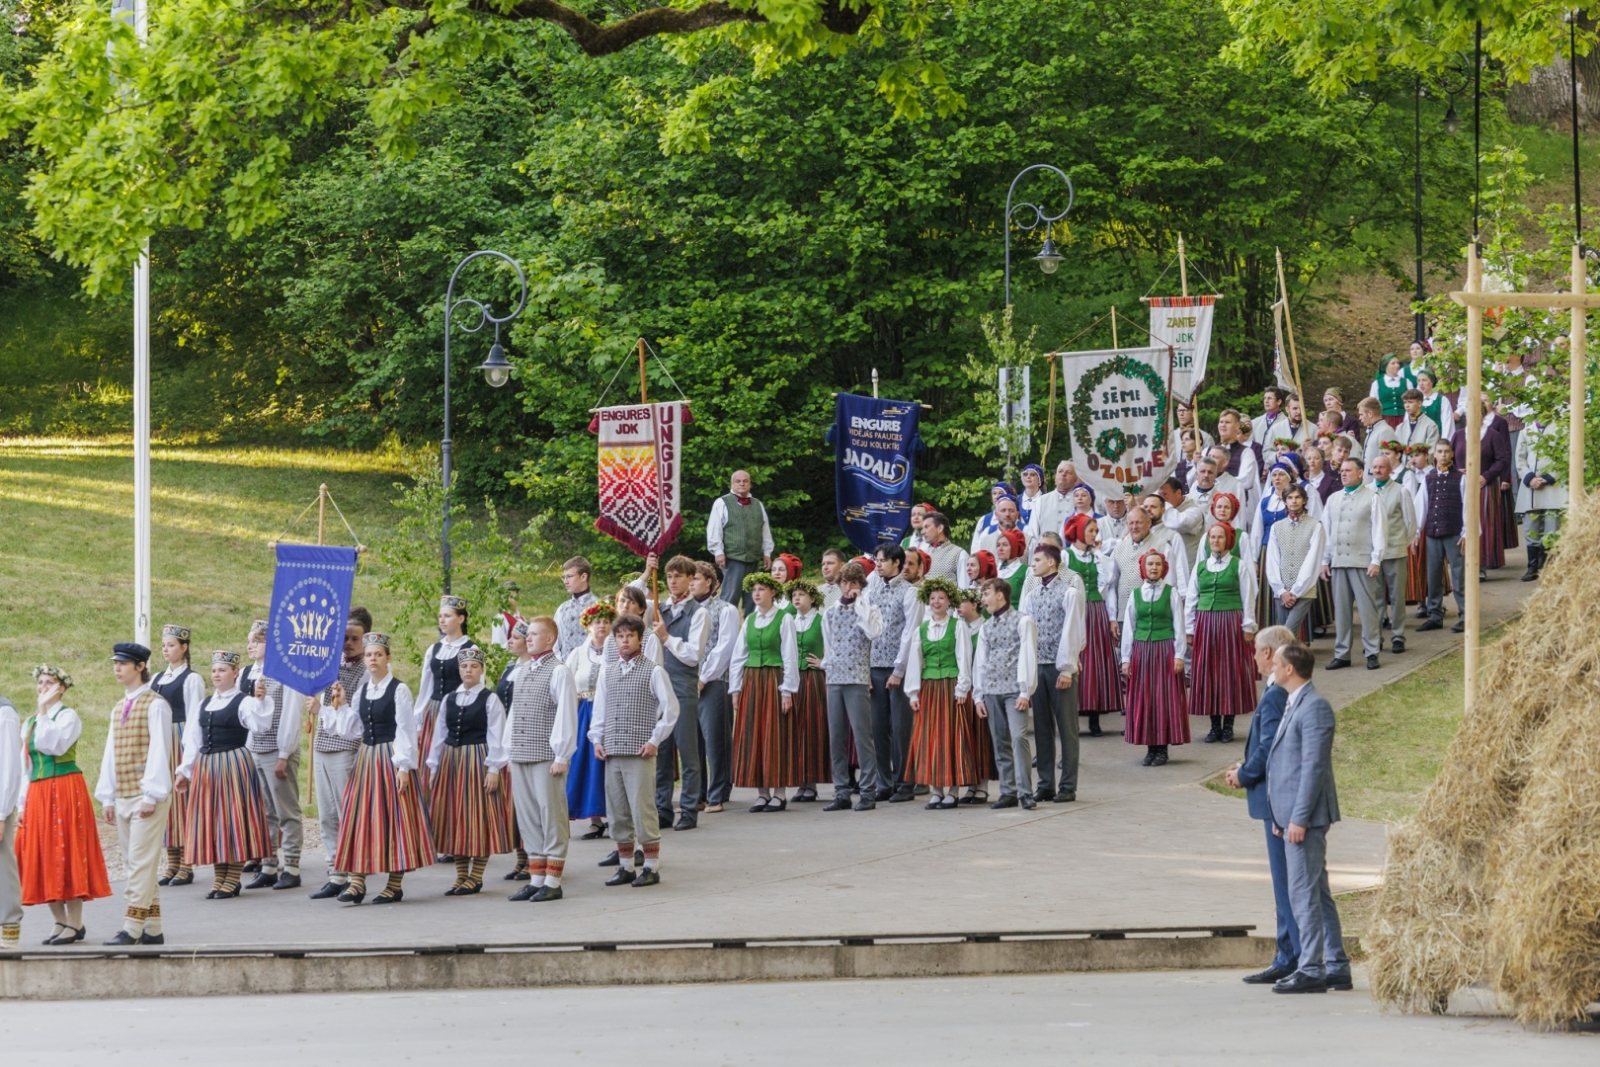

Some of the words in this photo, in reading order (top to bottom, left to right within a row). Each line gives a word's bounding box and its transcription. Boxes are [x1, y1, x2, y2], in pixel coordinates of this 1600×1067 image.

[1176, 333, 1194, 343] JDK
[601, 408, 651, 421] ENGURES
[615, 424, 639, 434] JDK
[660, 405, 674, 519] UNGURS
[288, 641, 329, 660] ZĪTARIŅI
